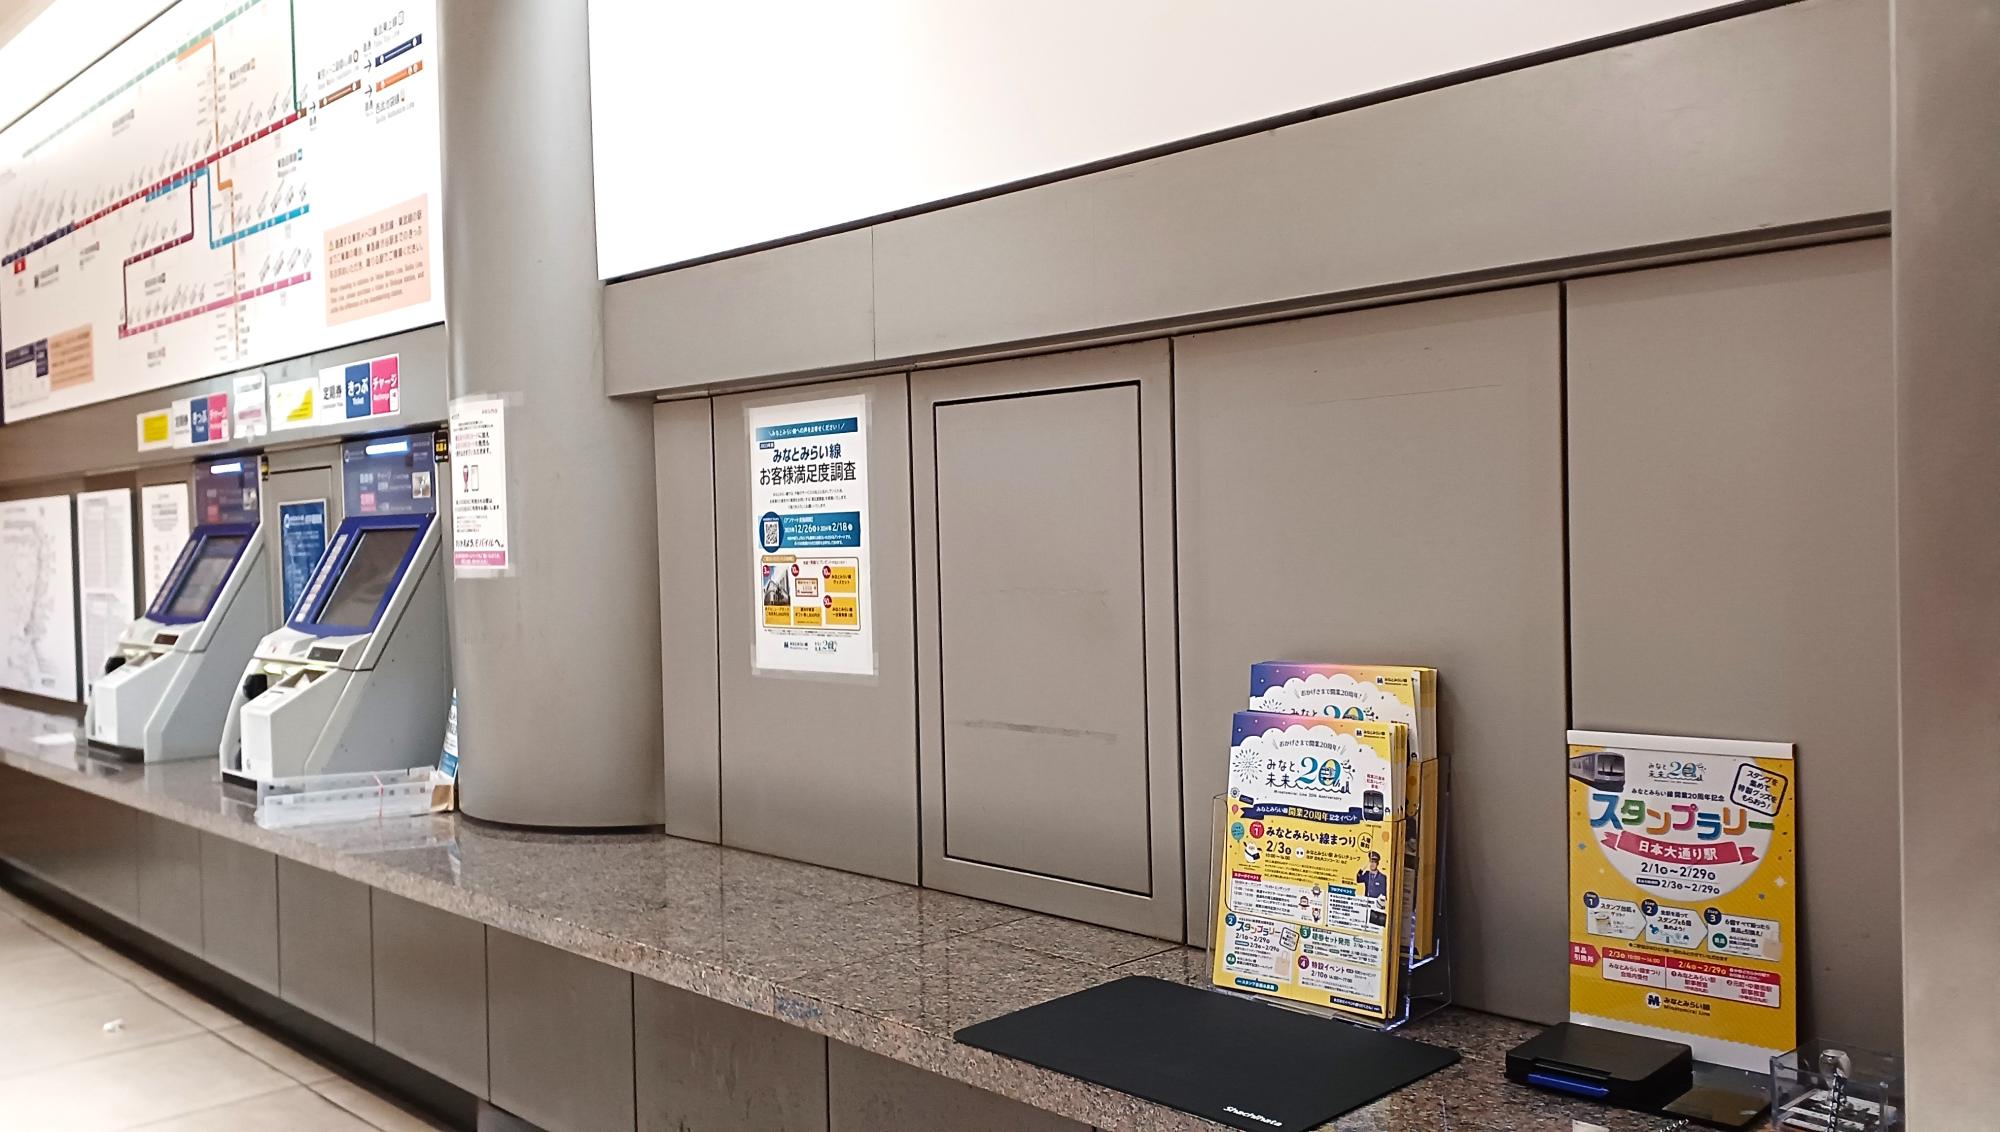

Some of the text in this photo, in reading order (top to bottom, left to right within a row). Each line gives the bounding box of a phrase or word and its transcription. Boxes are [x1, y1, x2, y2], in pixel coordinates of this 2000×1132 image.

[347, 377, 369, 397] きっぷ
[372, 374, 397, 391] チャージ
[773, 443, 842, 463] みなとみらい線
[760, 461, 857, 486] お客様満足度調査
[1590, 793, 1775, 841] スタンプラリー
[1266, 827, 1356, 848] みなとみらい線まつり
[1638, 840, 1718, 861] 日本大通り駅
[1647, 906, 1652, 914] 2
[1236, 921, 1281, 936] スタンプラリー
[1664, 996, 1711, 1011] みなとみらい線
[1223, 1105, 1283, 1127] Shachihata
